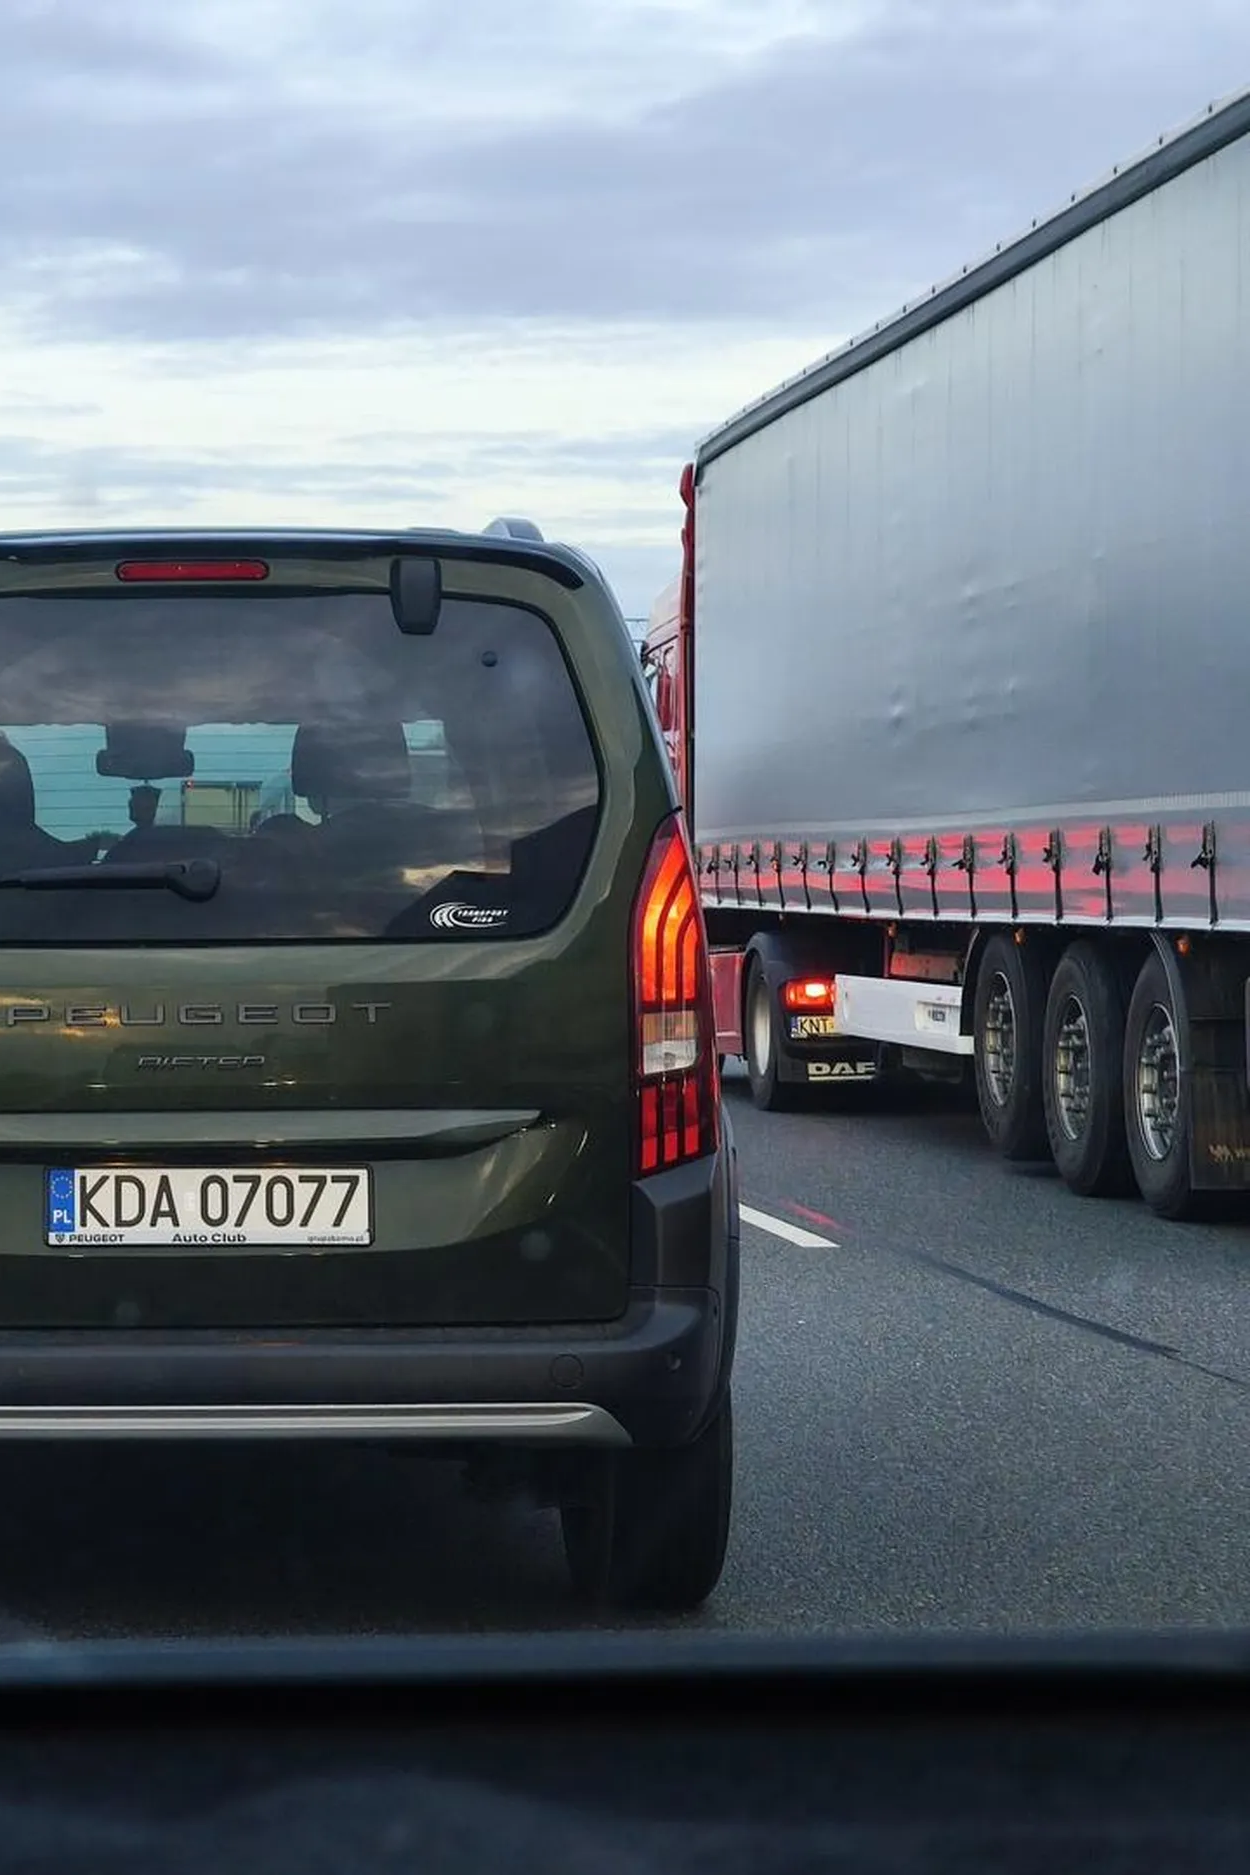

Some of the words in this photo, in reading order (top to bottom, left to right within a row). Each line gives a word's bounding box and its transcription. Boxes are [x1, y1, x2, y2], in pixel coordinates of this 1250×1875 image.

[6, 1002, 391, 1026] PEUGEOT
[807, 1062, 876, 1075] DAF
[79, 1175, 180, 1228] KDA
[200, 1175, 360, 1228] 07077
[53, 1210, 71, 1224] PL
[69, 1234, 125, 1243] PEUGEOT
[172, 1233, 208, 1243] Auto
[211, 1233, 247, 1243] Club
